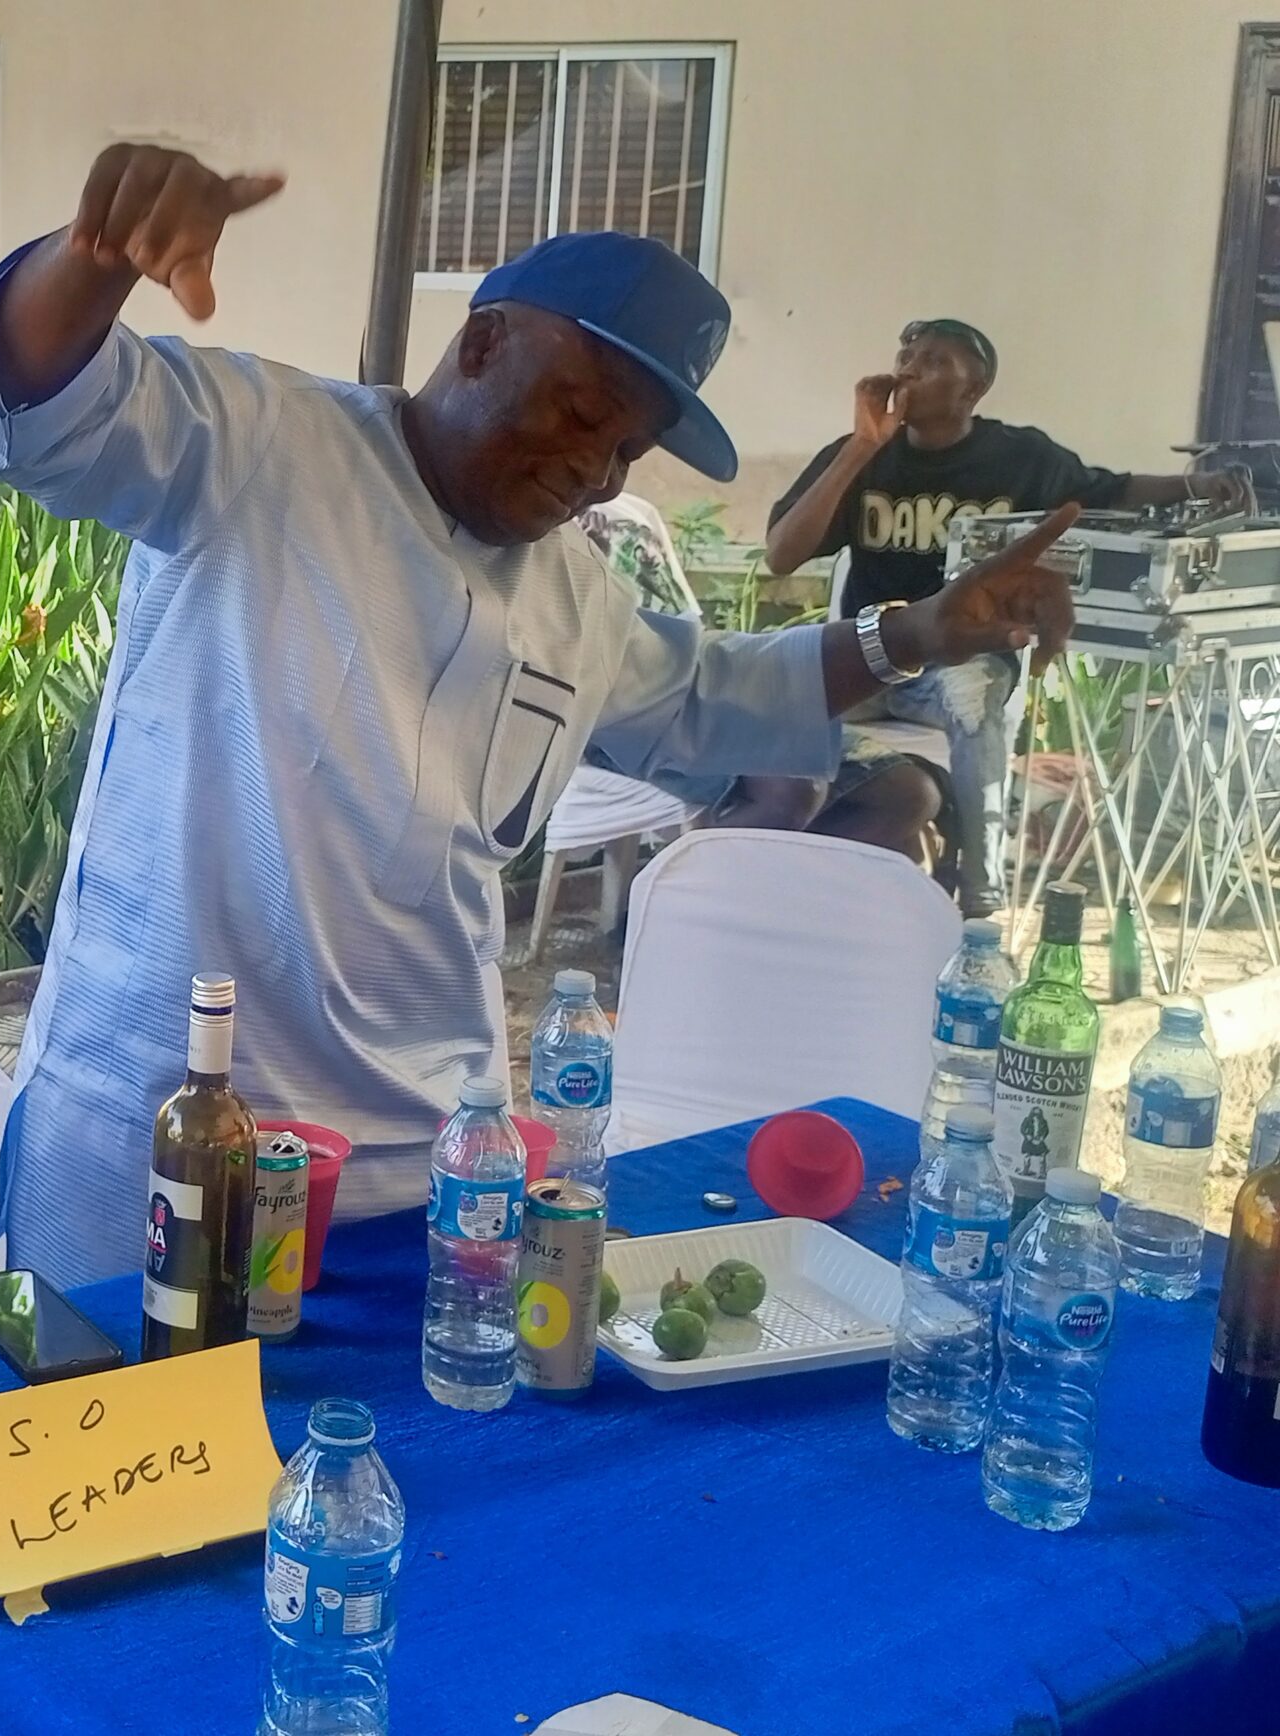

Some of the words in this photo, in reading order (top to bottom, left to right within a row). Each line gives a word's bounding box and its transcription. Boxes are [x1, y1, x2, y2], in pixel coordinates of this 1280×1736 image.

[859, 489, 1011, 552] DAK
[1002, 1047, 1085, 1077] WILLIAM
[9, 1440, 211, 1550] LEADERS
